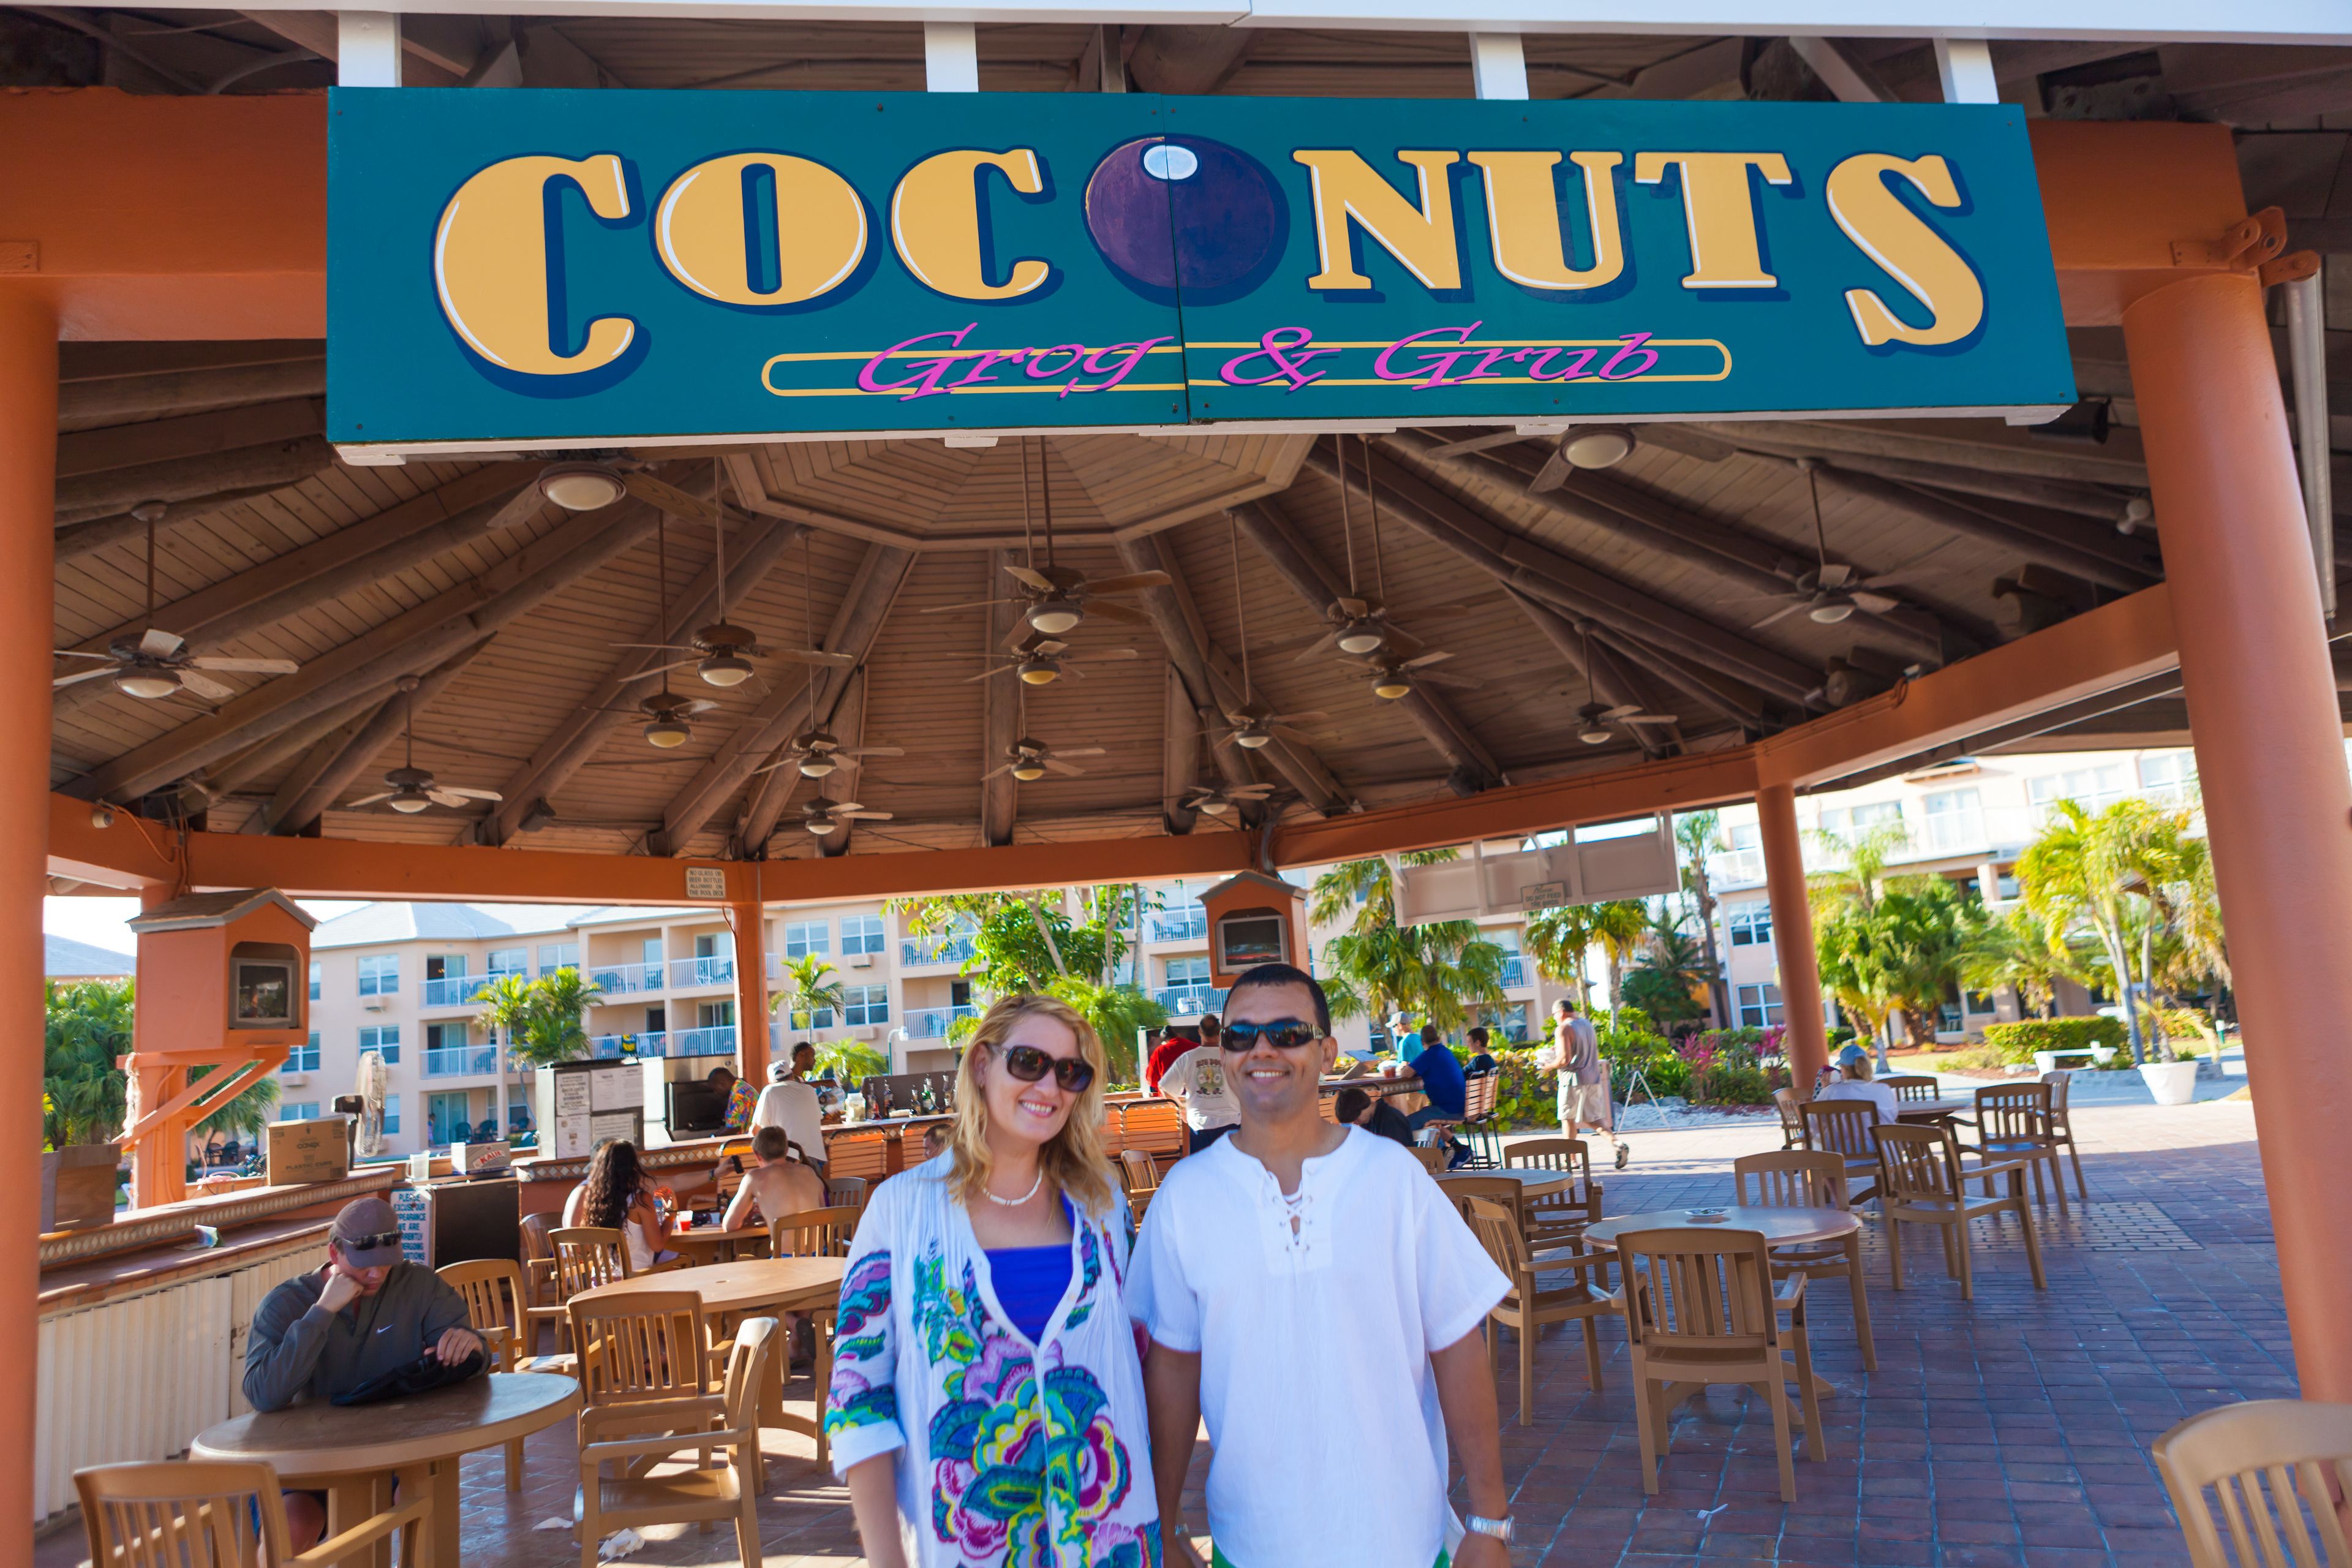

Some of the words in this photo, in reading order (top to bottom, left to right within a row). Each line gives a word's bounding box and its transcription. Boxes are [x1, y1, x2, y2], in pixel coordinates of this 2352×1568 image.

[856, 322, 1176, 401] Grog
[1218, 326, 1343, 392] &
[1372, 321, 1660, 392] Grub
